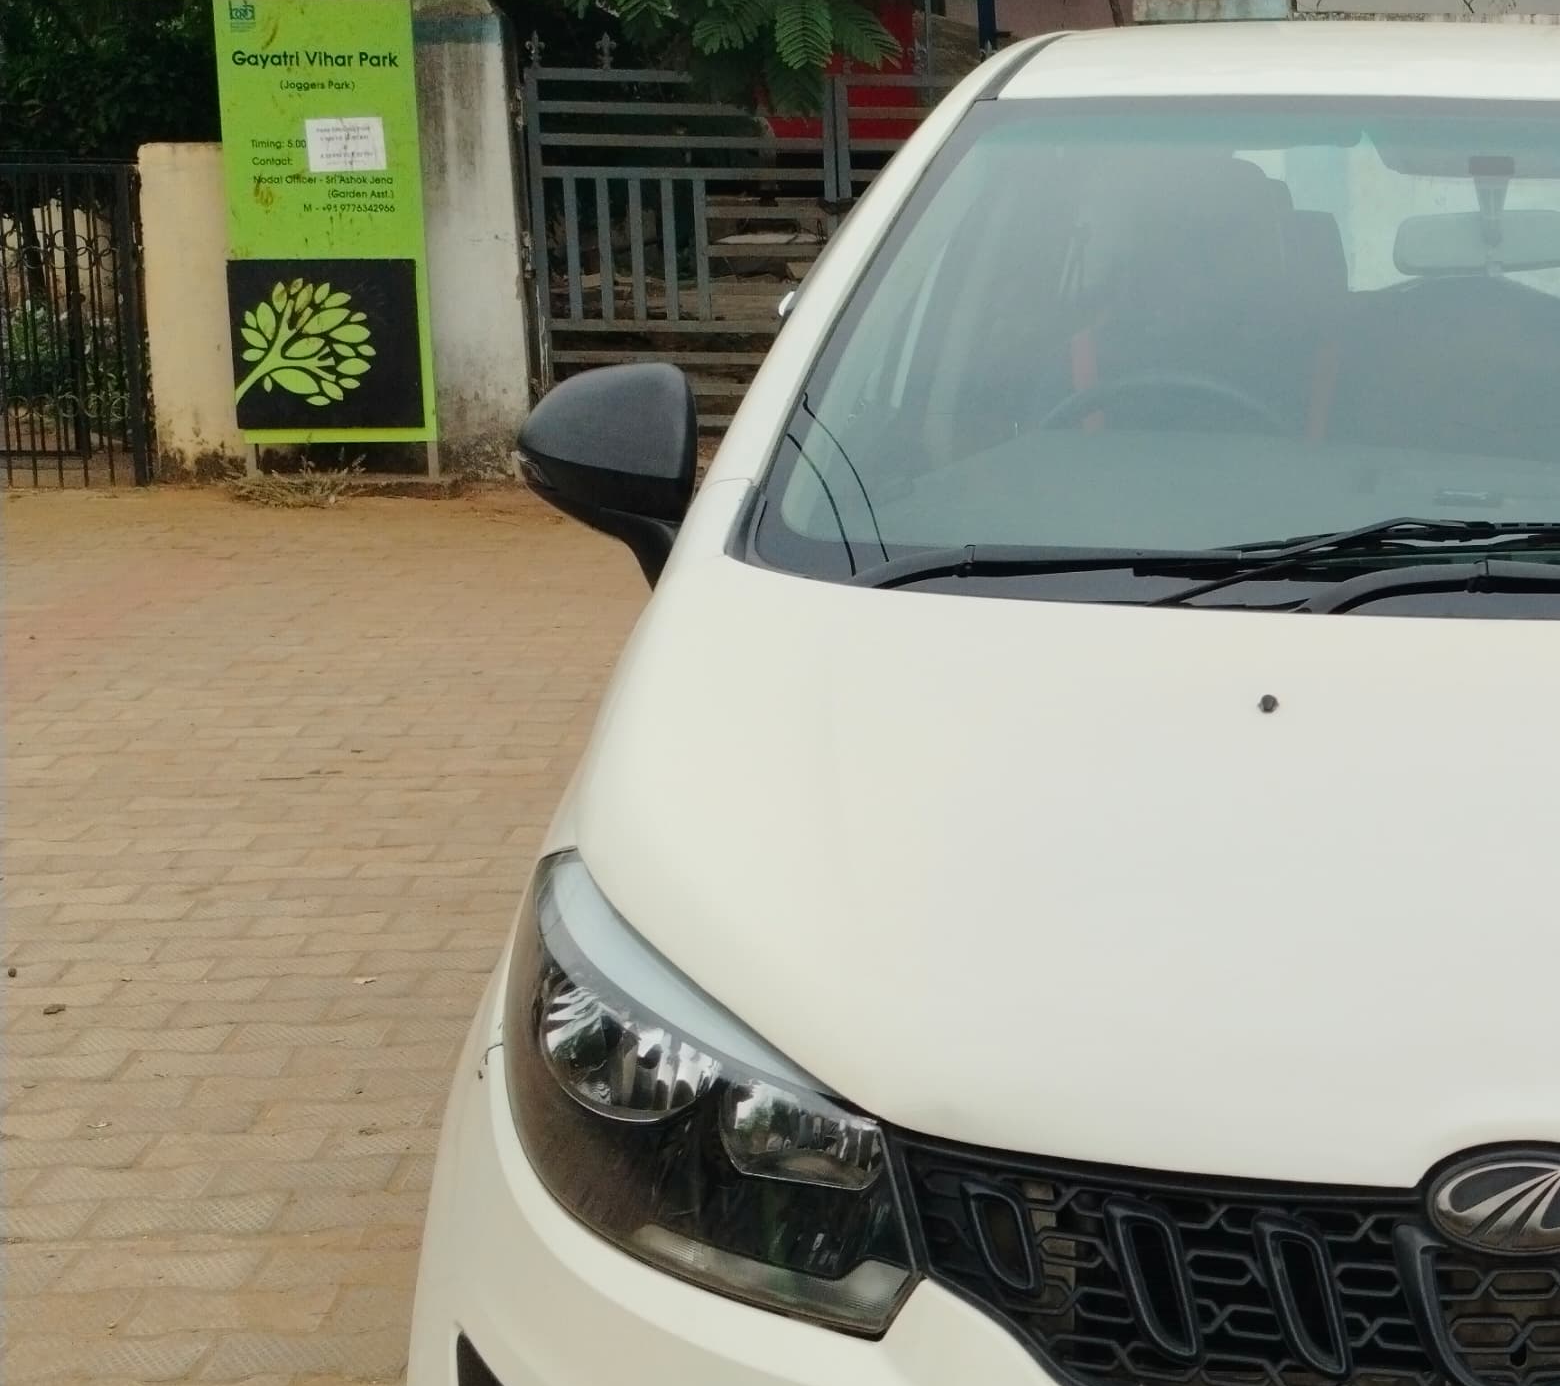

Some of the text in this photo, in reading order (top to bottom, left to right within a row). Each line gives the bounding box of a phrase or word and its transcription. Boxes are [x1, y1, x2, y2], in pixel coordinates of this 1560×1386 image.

[232, 50, 399, 69] Gayatri Vihar Park
[280, 80, 356, 91] (Joggers Park)
[251, 139, 285, 149] Timing:
[252, 157, 293, 166] Contact:
[253, 175, 282, 184] Nodal
[285, 174, 317, 184] Officer
[339, 175, 367, 184] Ashok
[369, 175, 393, 184] Jena
[328, 189, 367, 199] (Garden
[303, 204, 312, 213] M
